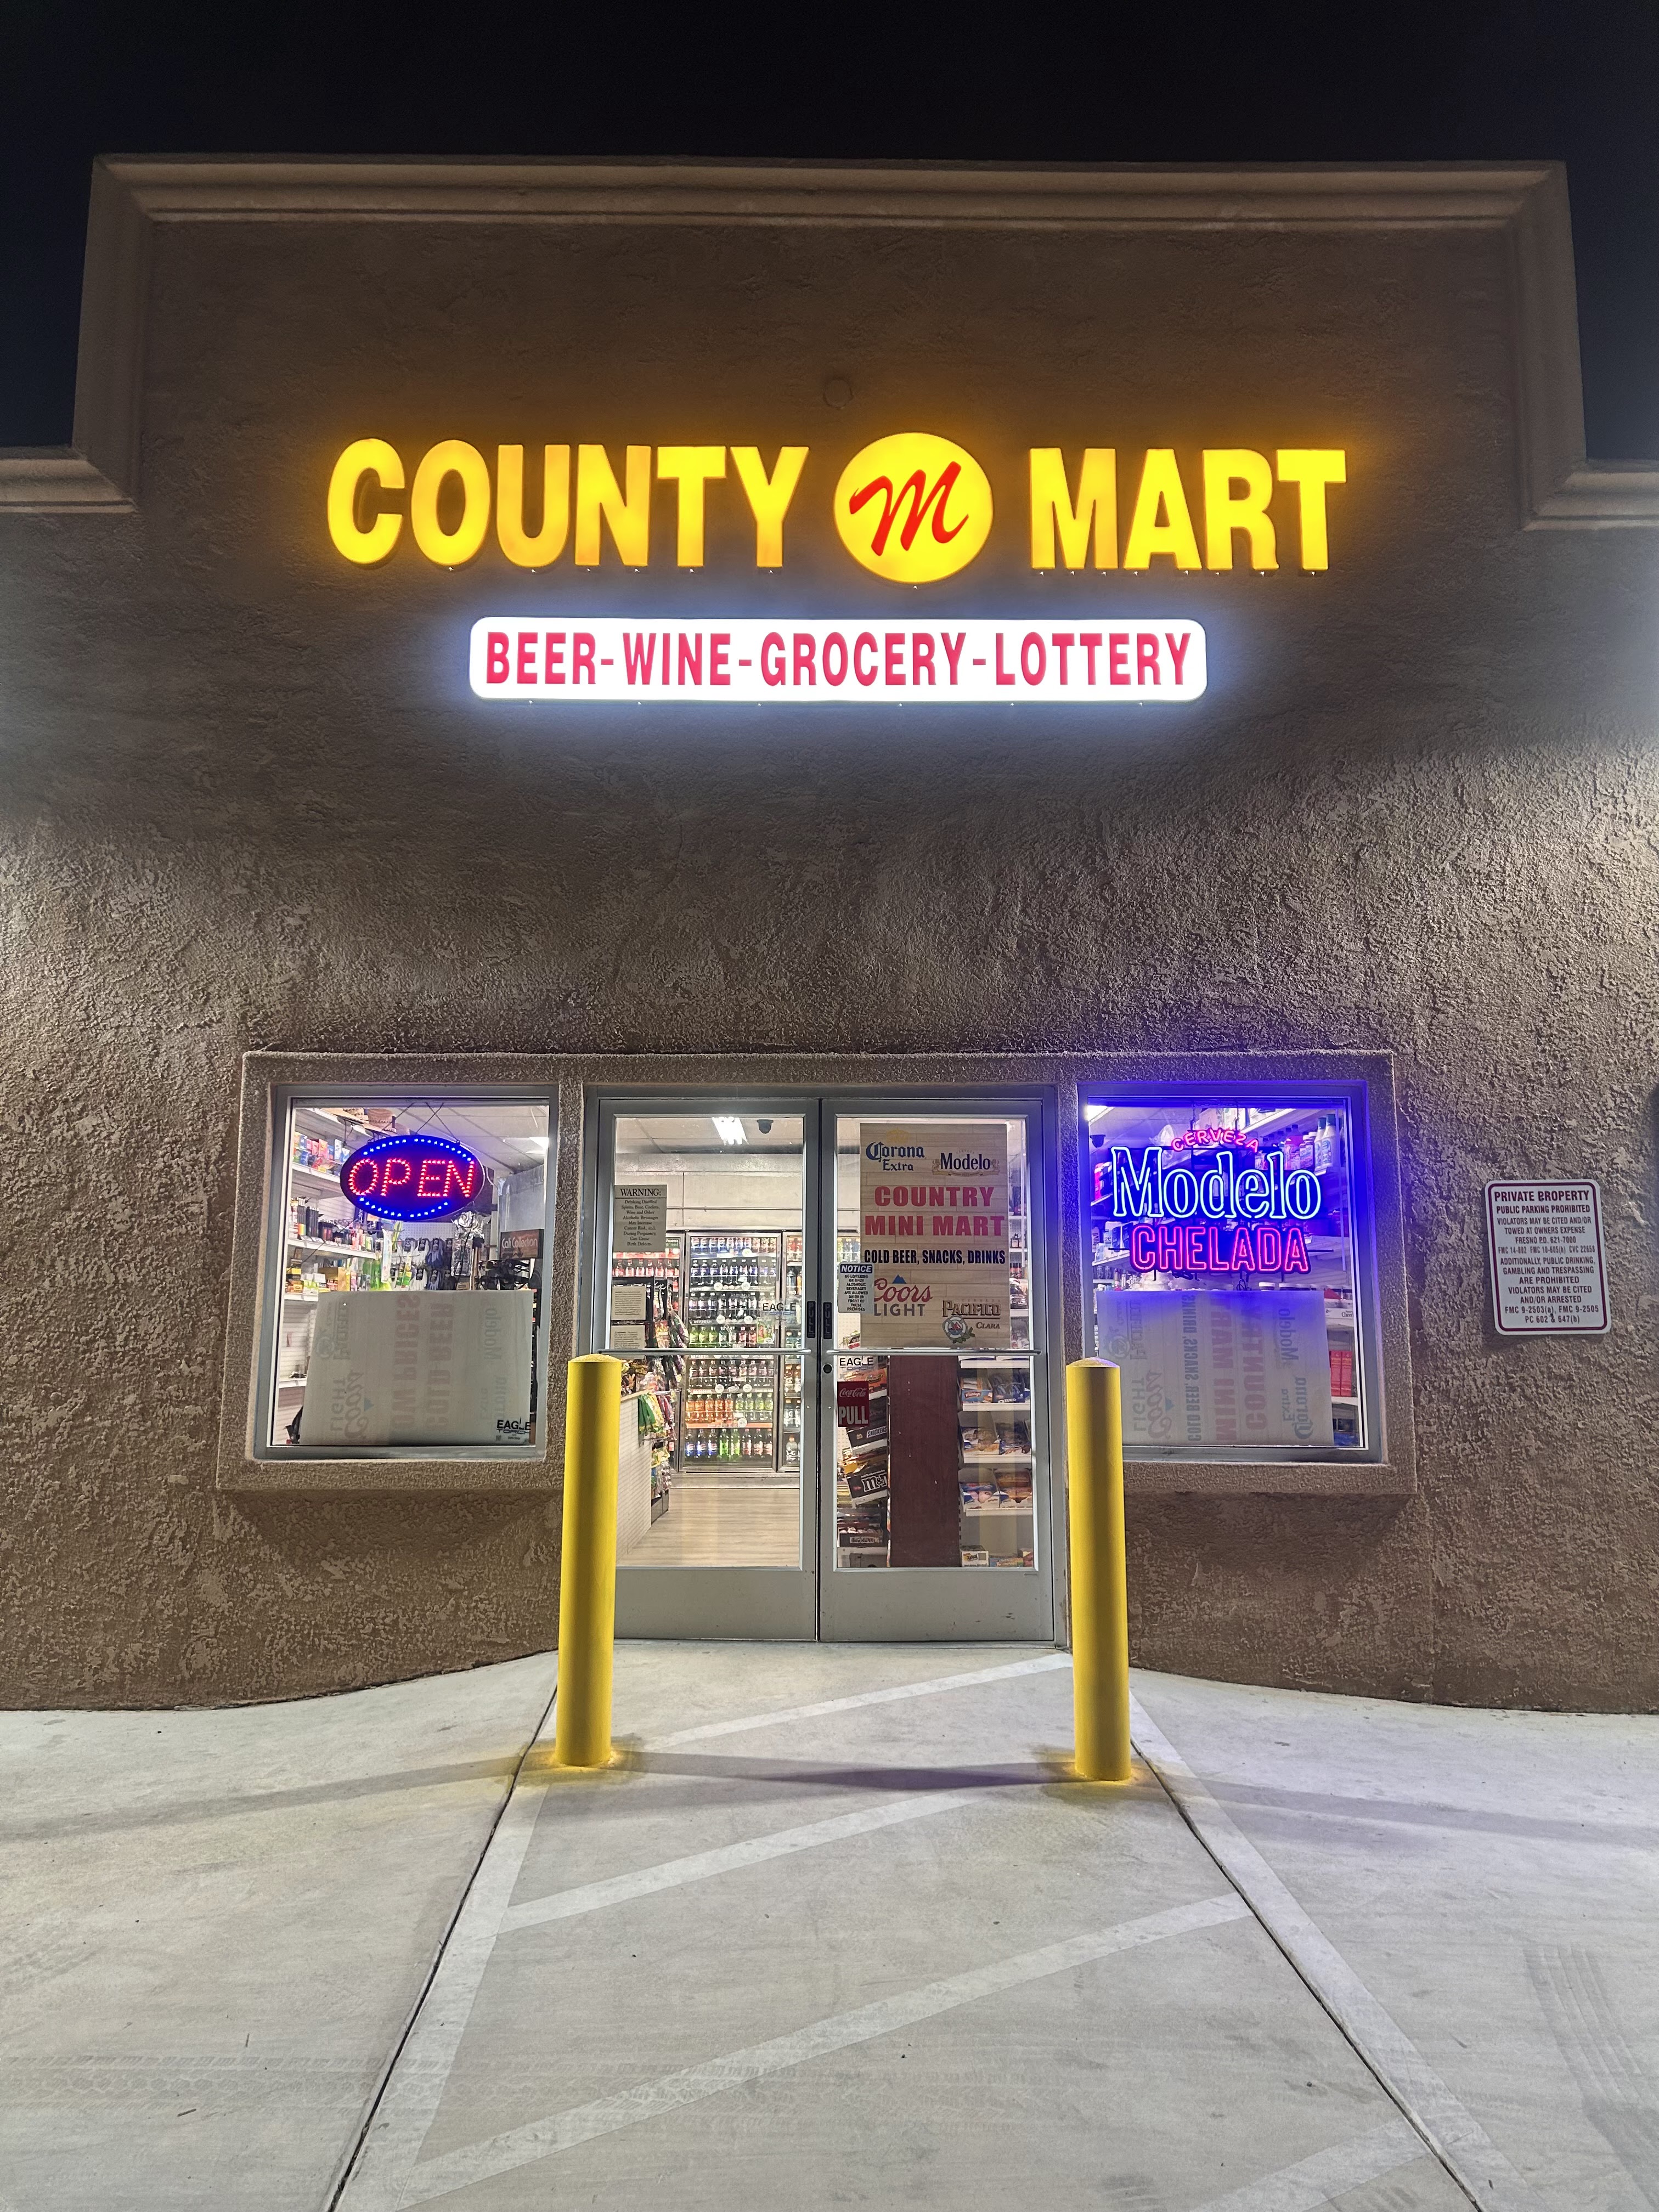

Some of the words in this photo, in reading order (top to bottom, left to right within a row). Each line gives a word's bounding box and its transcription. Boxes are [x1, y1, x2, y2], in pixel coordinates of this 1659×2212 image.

[327, 438, 809, 567] COUNTY
[1030, 447, 1346, 571] MART
[1171, 1127, 1259, 1153] CERVEZA
[866, 1142, 925, 1162] Corona
[882, 1159, 913, 1171] Extra
[941, 1153, 991, 1170] Modelo
[348, 1158, 475, 1197] OPEN
[1111, 1146, 1322, 1219] Modelo
[620, 1188, 662, 1197] WARNING:
[874, 1186, 994, 1207] COUNTRY
[1494, 1192, 1534, 1201] PRIVATE
[1538, 1190, 1589, 1201] PROPERTY
[865, 1215, 924, 1235] MINI
[933, 1216, 1005, 1236] MART
[512, 1236, 538, 1248] Collection
[1131, 1224, 1310, 1272] CHELADA
[864, 1249, 889, 1264] COLD
[893, 1250, 919, 1265] BEER,
[922, 1249, 965, 1266] SNACKS,
[968, 1249, 1005, 1264] DRINKS
[1500, 1257, 1542, 1266] ADDITIONALLY,
[874, 1278, 933, 1302] Coors
[763, 1302, 796, 1311] EAGLE
[874, 1304, 925, 1317] LIGHT
[943, 1300, 1001, 1317] PACIFICO
[839, 1356, 874, 1365] EAGLE
[496, 1417, 531, 1430] EAGLE
[839, 1406, 868, 1425] PULL
